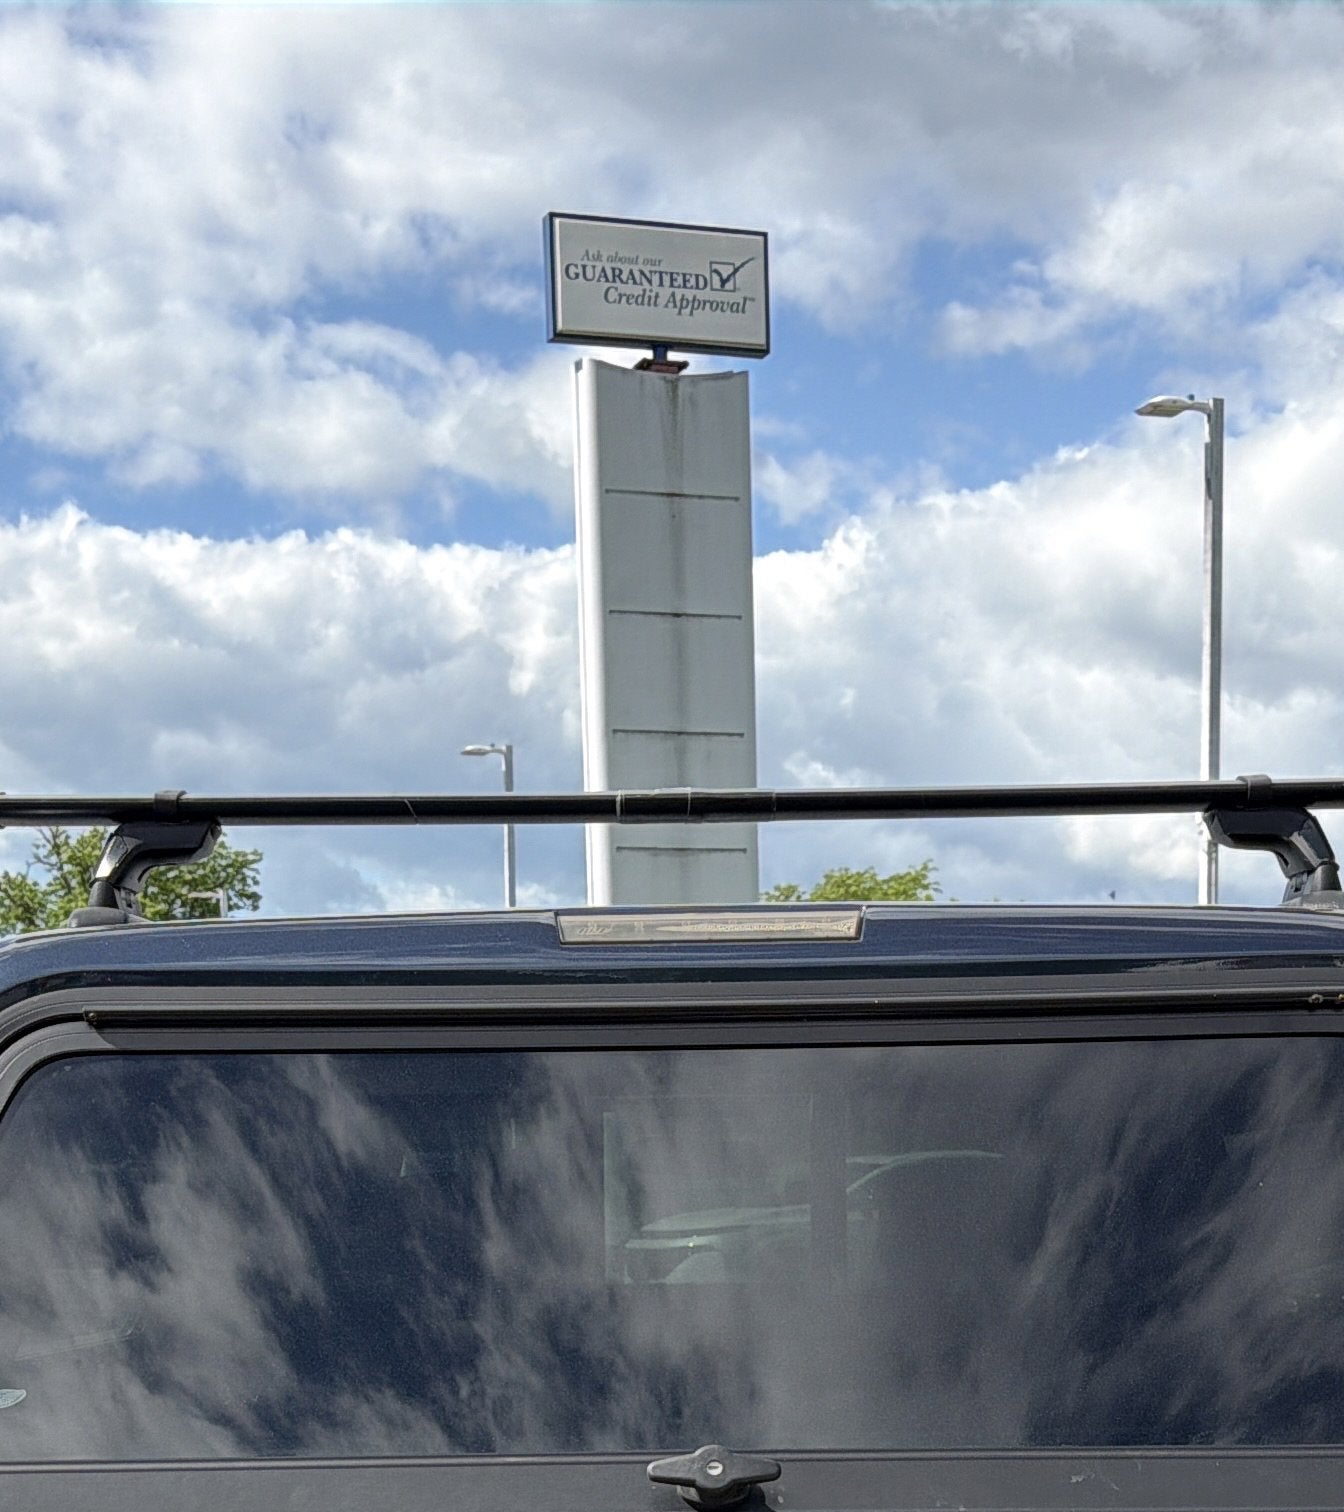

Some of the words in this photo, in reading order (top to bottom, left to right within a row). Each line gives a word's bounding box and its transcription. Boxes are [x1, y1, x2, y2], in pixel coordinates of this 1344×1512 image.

[581, 249, 604, 263] Ask
[606, 251, 639, 266] about
[642, 257, 664, 267] our
[564, 263, 709, 291] GUARANTEED
[603, 286, 661, 308] Credit
